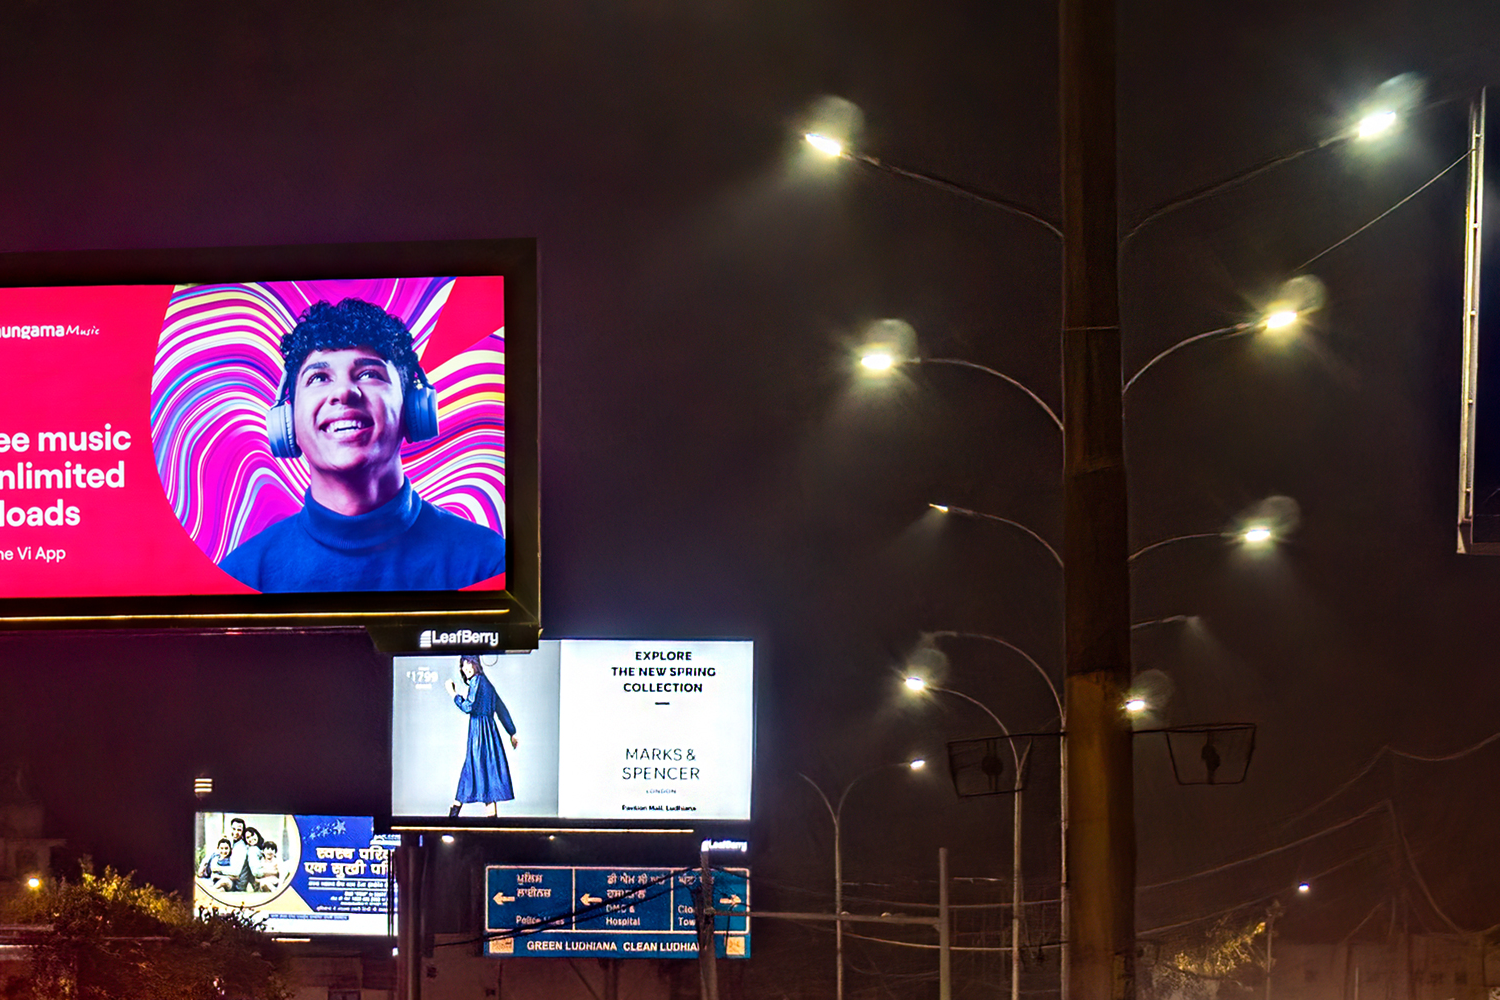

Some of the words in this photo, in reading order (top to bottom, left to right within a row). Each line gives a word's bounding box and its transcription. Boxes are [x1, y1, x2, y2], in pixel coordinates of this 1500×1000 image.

[38, 423, 132, 452] music
[17, 547, 32, 560] Vi
[35, 547, 66, 563] App
[432, 630, 499, 648] LeafBerry
[635, 651, 692, 661] EXPLORE
[611, 667, 635, 677] THE
[638, 667, 667, 677] NEW
[669, 667, 716, 677] SPRING
[623, 682, 703, 693] COLLECTION
[625, 748, 683, 761] MARKS
[686, 749, 697, 761] &
[622, 767, 700, 780] SPENCER
[304, 861, 328, 875] एक
[678, 904, 694, 914] Clo
[606, 917, 640, 927] Hospital
[678, 917, 696, 926] Tow
[527, 941, 562, 951] GREEN
[565, 941, 617, 951] LUDHIANA
[623, 941, 656, 952] CLEAN
[659, 942, 699, 952] LUDHIA
